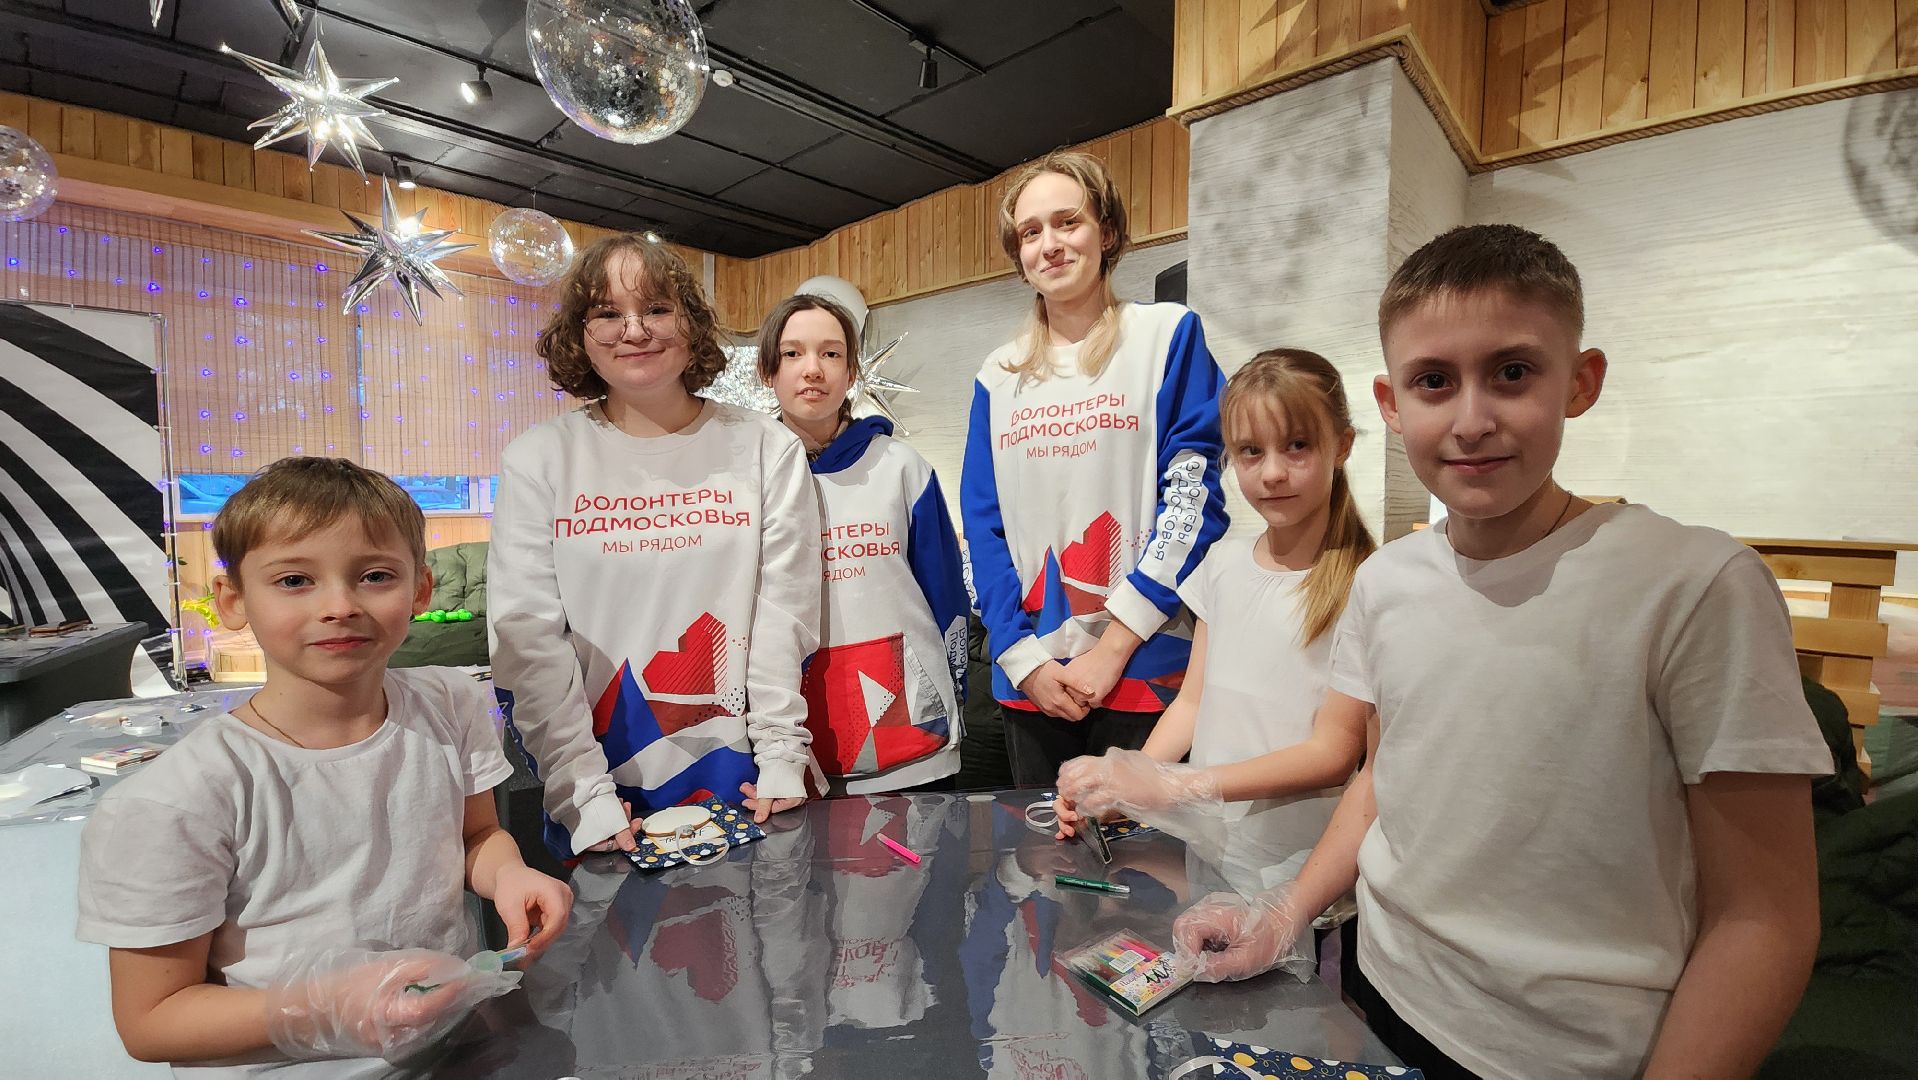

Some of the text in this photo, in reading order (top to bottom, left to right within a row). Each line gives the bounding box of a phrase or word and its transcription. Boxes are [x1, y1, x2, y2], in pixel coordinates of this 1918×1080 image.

[1011, 393, 1126, 427] ВОЛОНТЕРЫ
[1000, 413, 1139, 450] ПОДМОСКОВЬЯ
[1026, 439, 1097, 459] МЫ РЯДОМ
[574, 488, 733, 513] ВОЛОНТЕРЫ
[555, 509, 750, 538] ПОДМОСКОВЬЯ
[820, 522, 890, 541] НТЕРЫ
[602, 534, 702, 554] МЫ РЯДОМ
[821, 541, 901, 561] СКОВЬЯ
[823, 566, 866, 582] ЯДОМ
